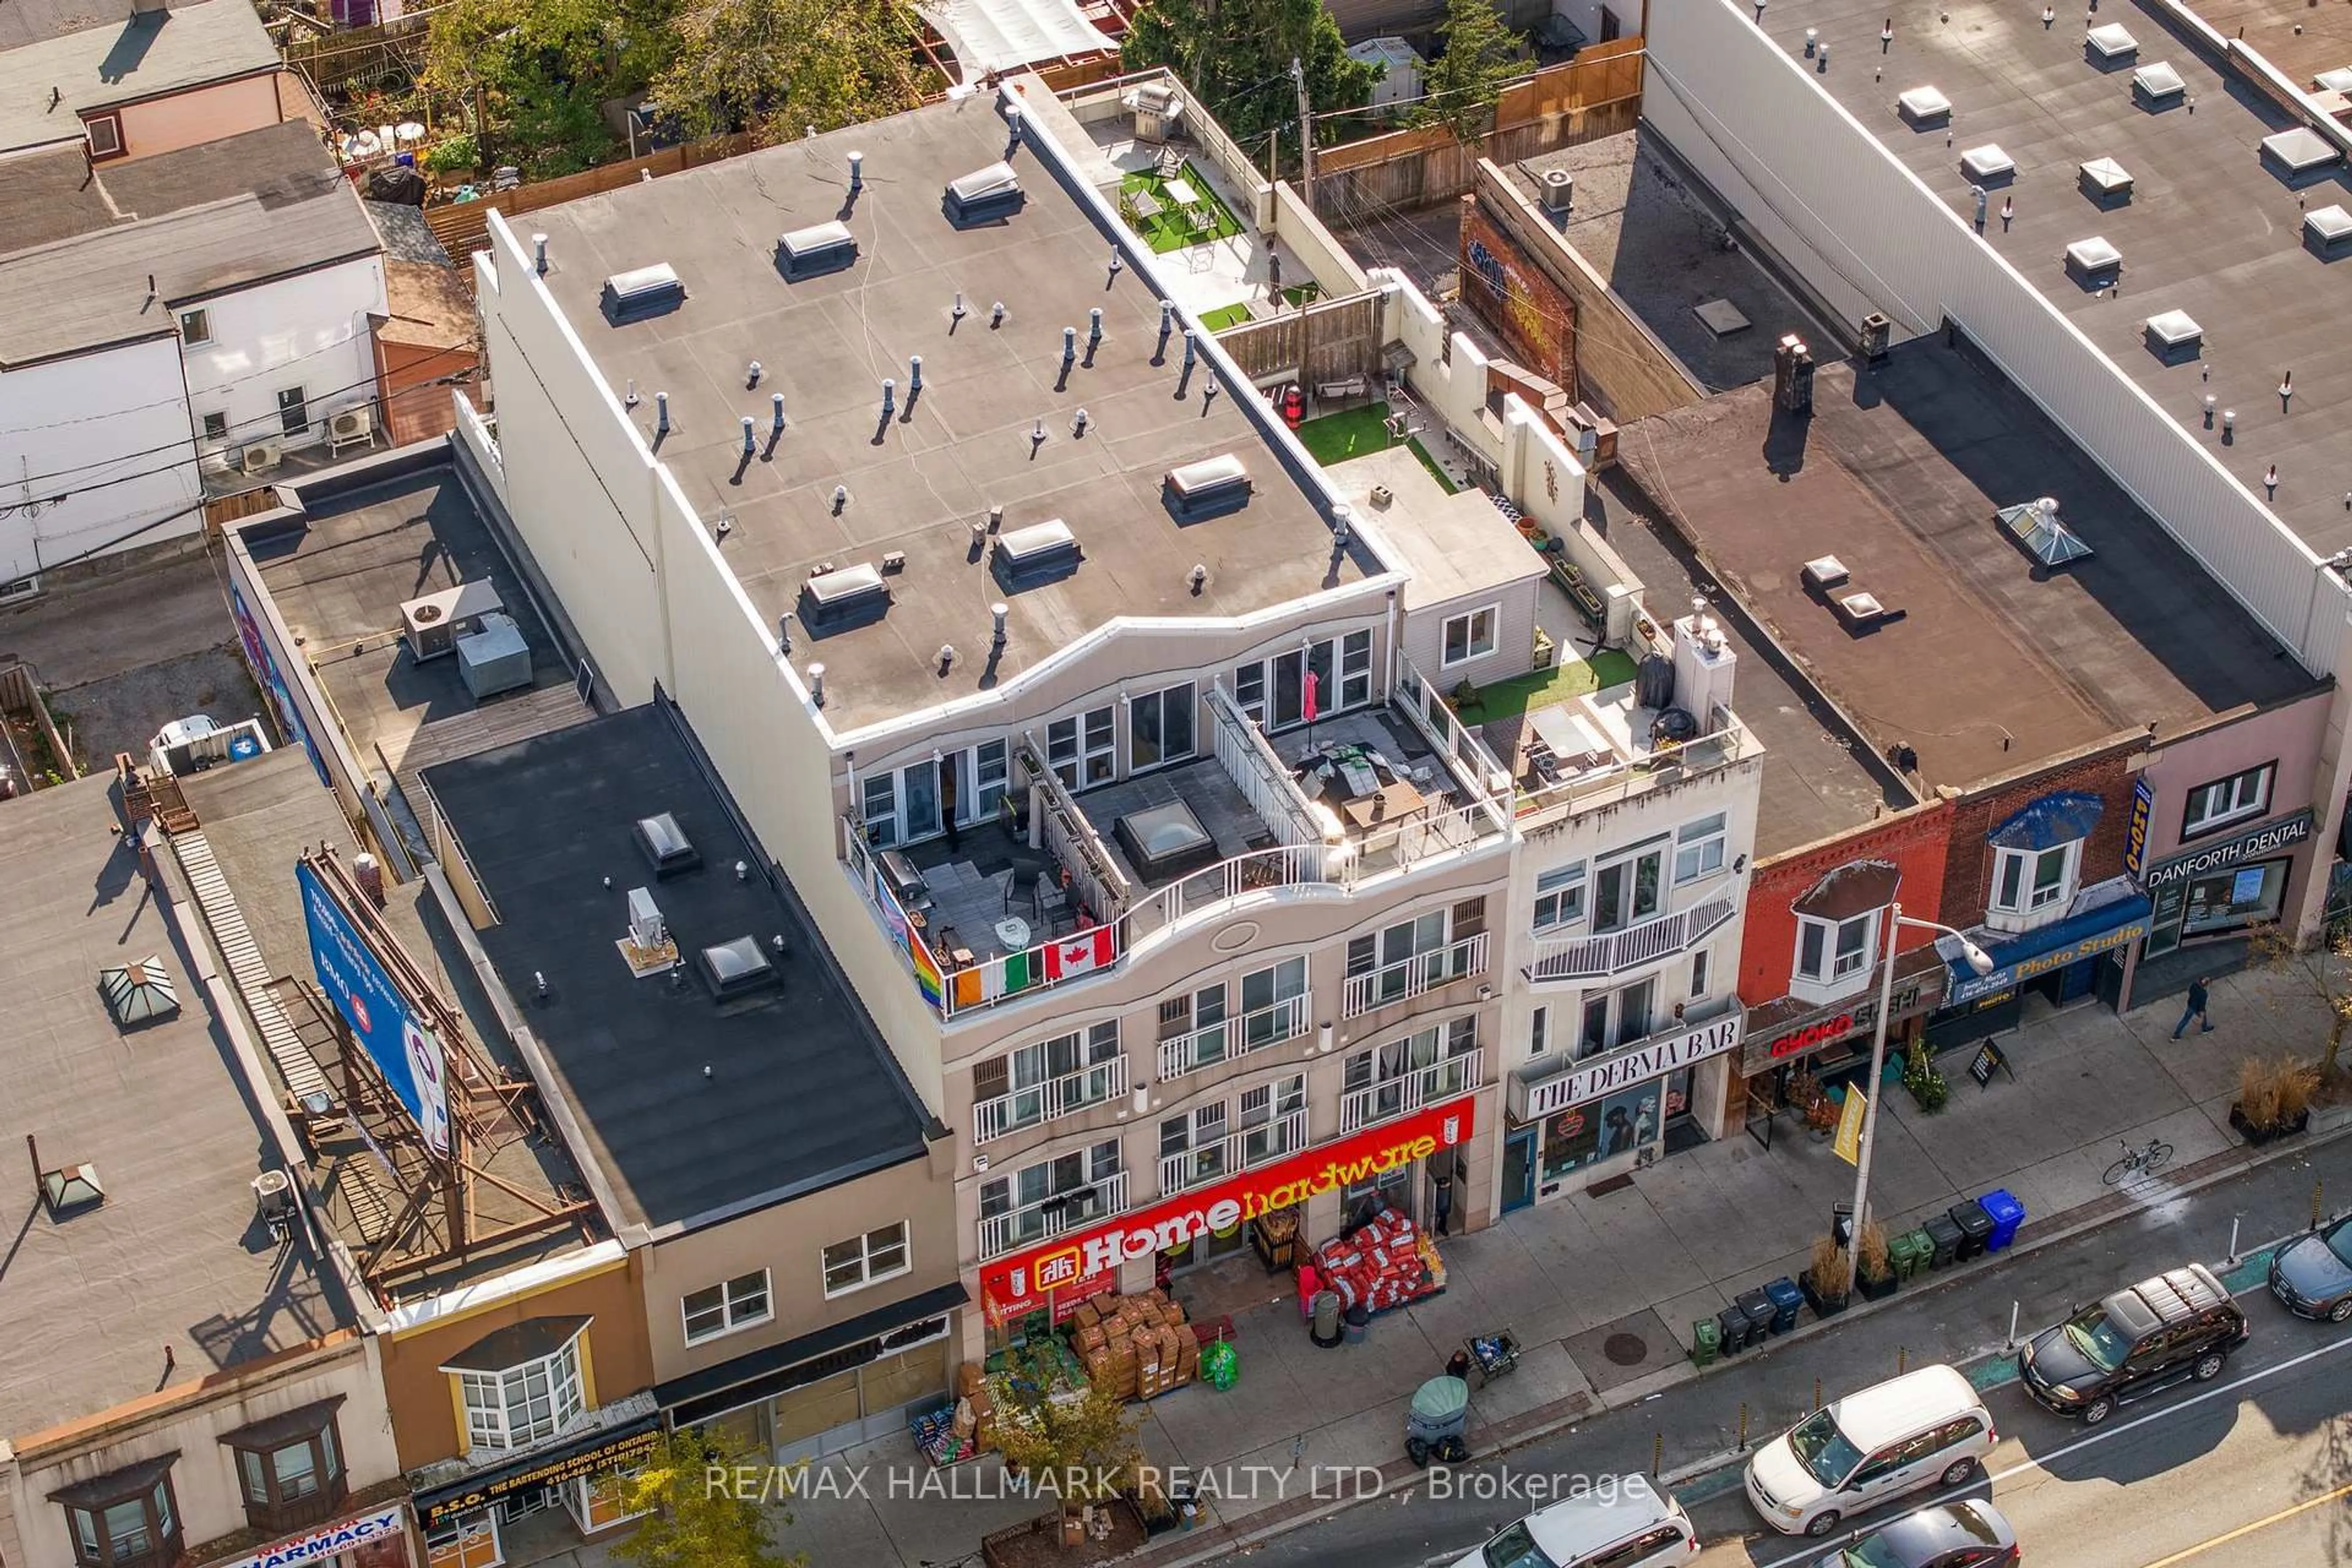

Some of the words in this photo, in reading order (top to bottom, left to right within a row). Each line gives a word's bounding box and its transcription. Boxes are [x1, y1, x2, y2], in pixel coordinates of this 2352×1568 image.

[2127, 797, 2148, 872] PHOTO
[2149, 843, 2241, 889] DANFORTH
[2245, 821, 2306, 854] DENTAL
[320, 950, 350, 1000] BMO
[2016, 951, 2073, 980] Photo
[2078, 925, 2143, 956] Studio
[1855, 987, 1920, 1027] SUSHI
[1534, 1073, 1581, 1111] THE
[1589, 1042, 1677, 1093] DERMA
[1686, 1021, 1735, 1058] BAR
[1083, 1199, 1240, 1276] Home
[1243, 1135, 1436, 1220] hardware
[431, 1493, 486, 1518] B.S.O.
[490, 1482, 508, 1494] THE
[509, 1461, 565, 1488] BARTENDING
[567, 1450, 603, 1469] SCHOOL
[604, 1444, 616, 1455] OF
[618, 1430, 658, 1450] ONTARIO
[256, 1537, 306, 1559] NEW
[314, 1519, 360, 1539] ERA
